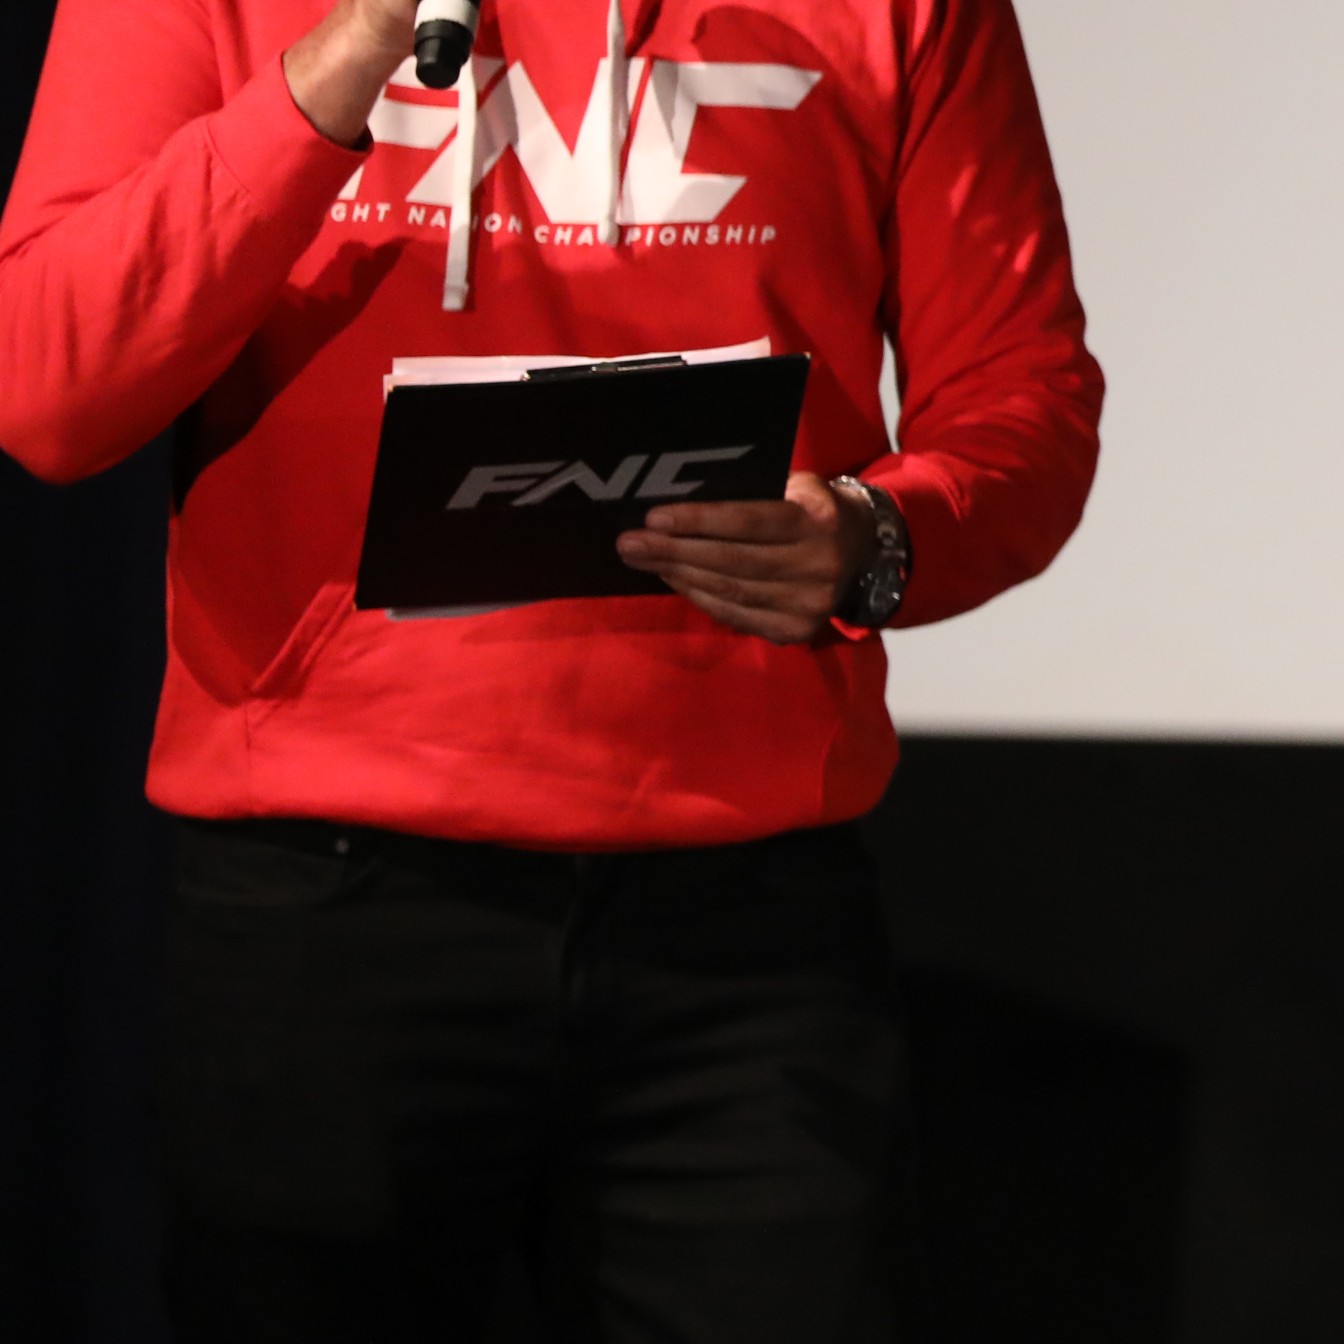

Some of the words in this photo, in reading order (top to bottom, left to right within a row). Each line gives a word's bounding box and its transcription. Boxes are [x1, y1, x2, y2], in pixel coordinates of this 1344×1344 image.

[331, 202, 391, 223] GHT
[408, 207, 522, 234] NAION
[534, 225, 776, 246] CHAPIONSHIP
[446, 445, 754, 510] FNC
